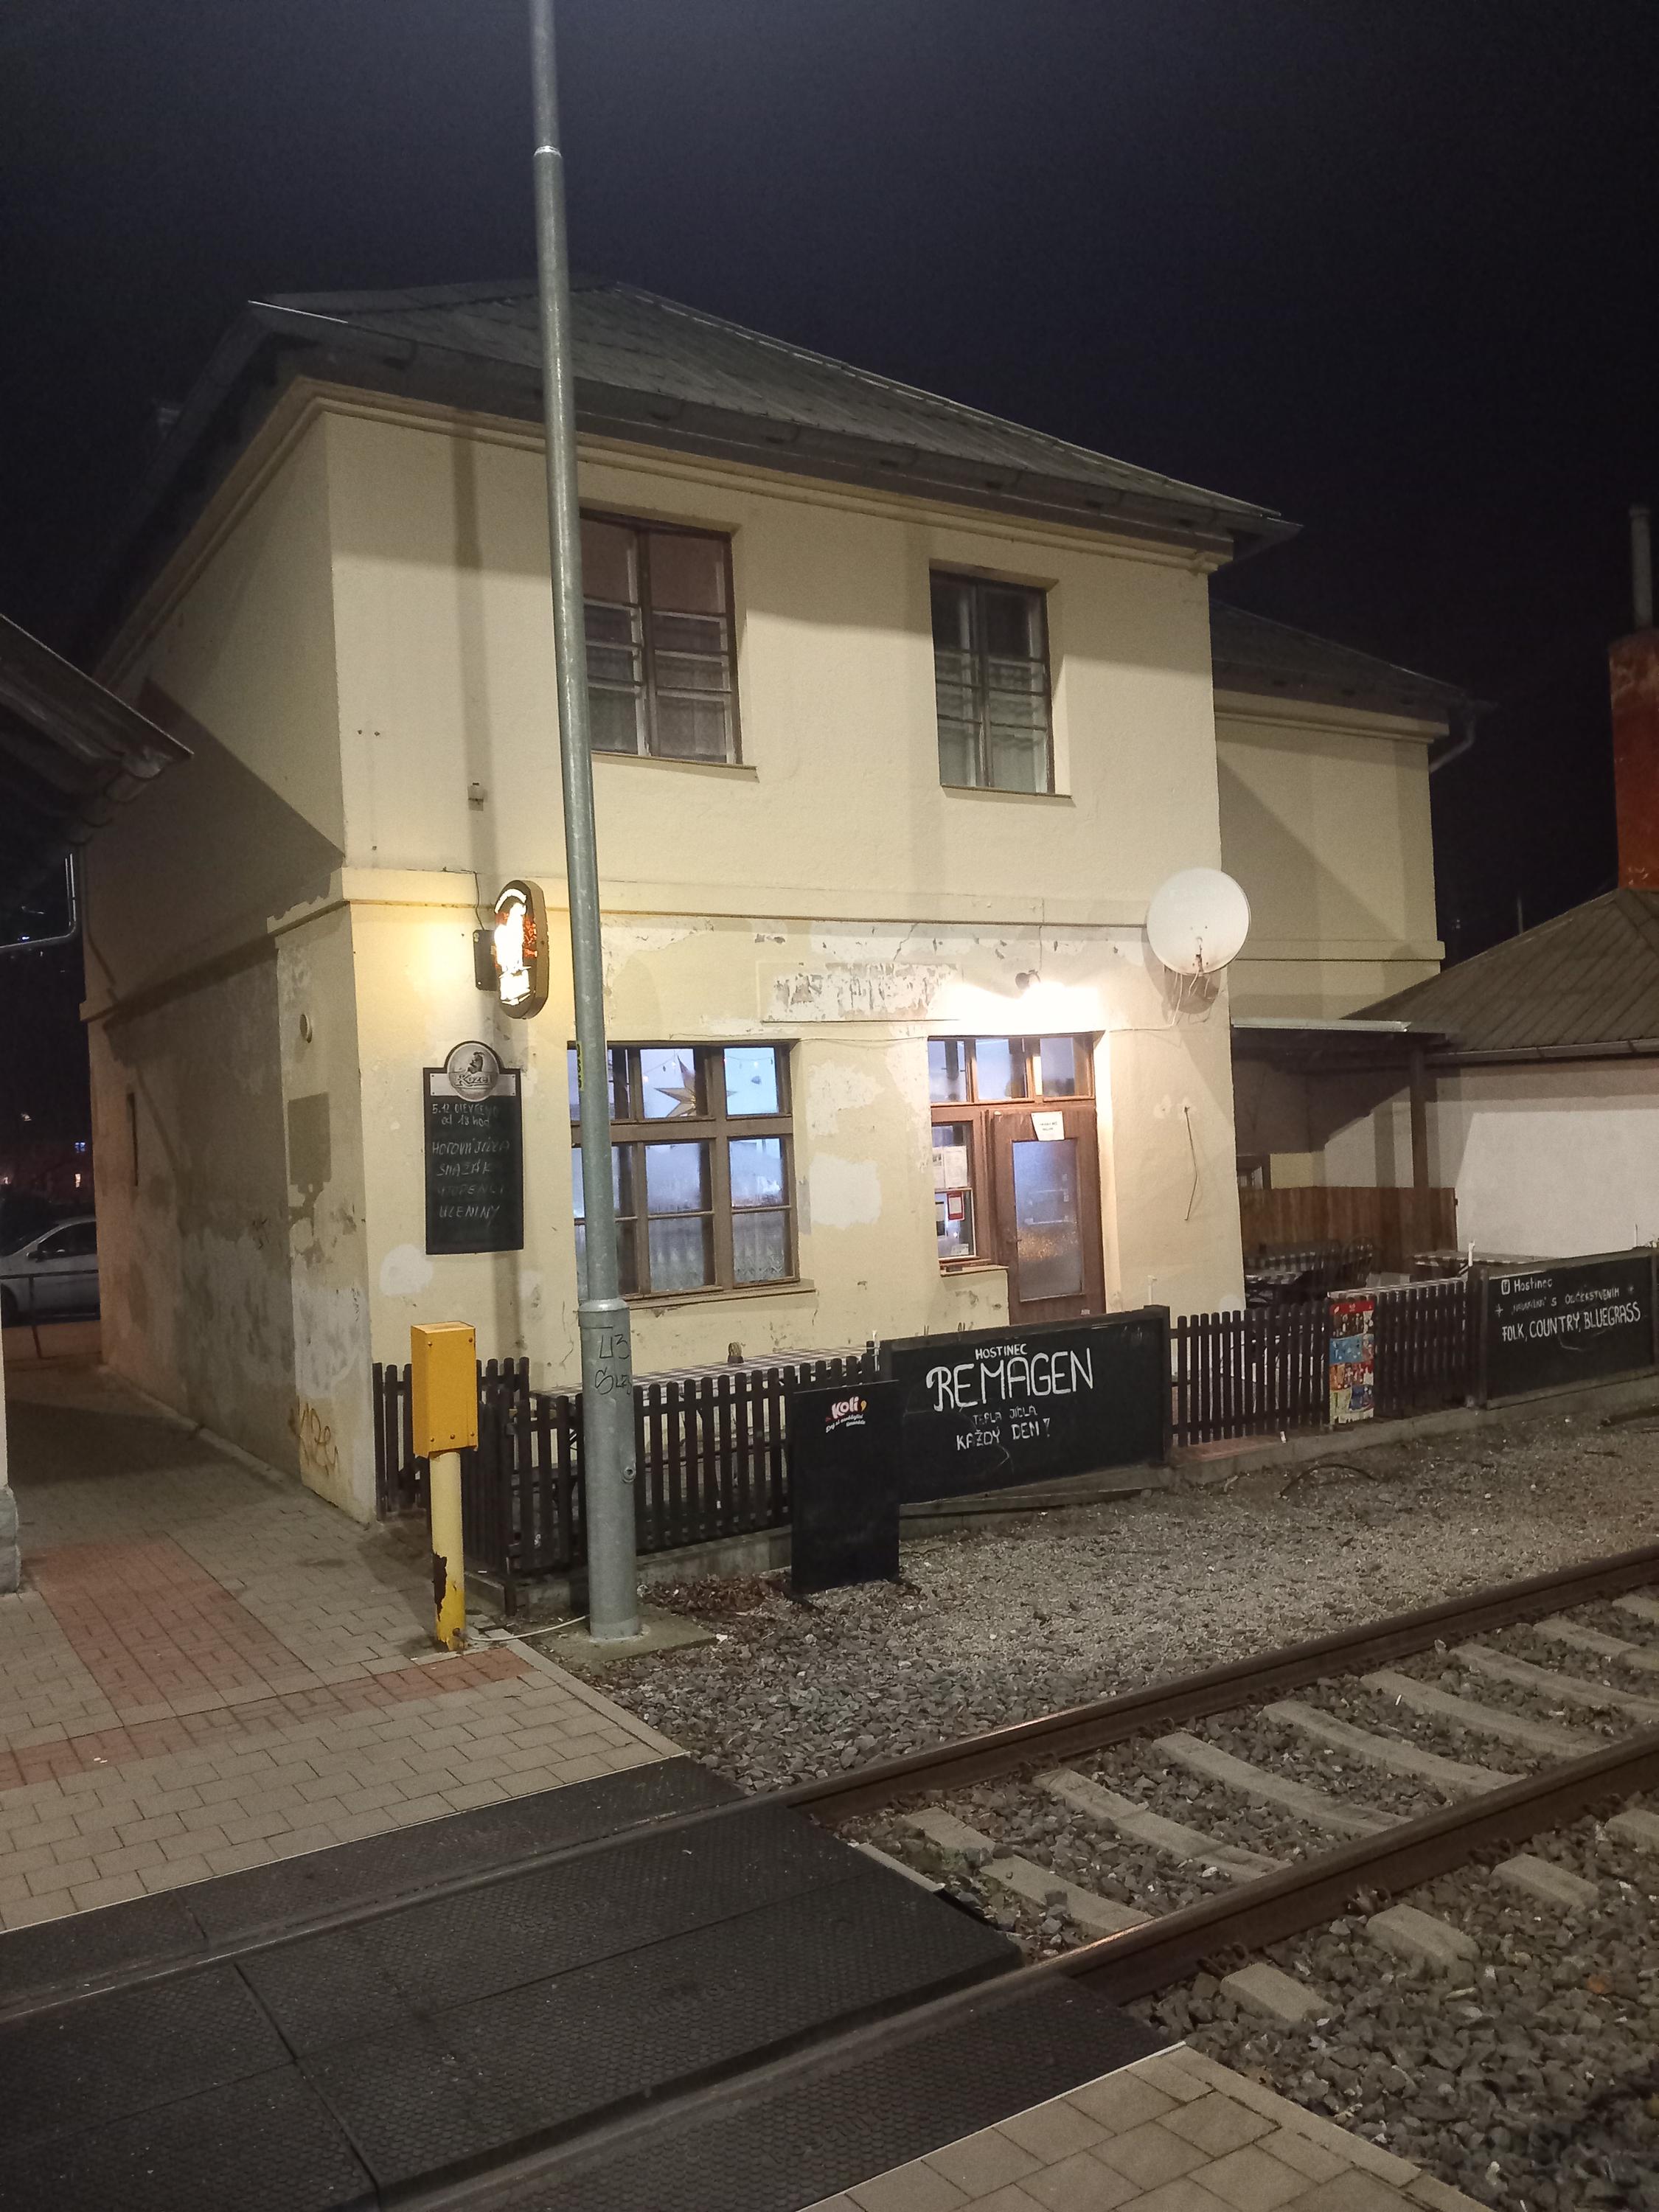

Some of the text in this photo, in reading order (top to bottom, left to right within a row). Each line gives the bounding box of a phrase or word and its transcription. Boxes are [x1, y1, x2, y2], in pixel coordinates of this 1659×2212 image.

[441, 1114, 452, 1125] od
[1502, 1301, 1641, 1342] FOLK, COUNTRY, BLUEGRASS
[975, 1343, 1028, 1360] HOSTINEC
[925, 1348, 1093, 1412] REMAGEN
[832, 1396, 859, 1419] Koli
[1012, 1420, 1040, 1441] DEN
